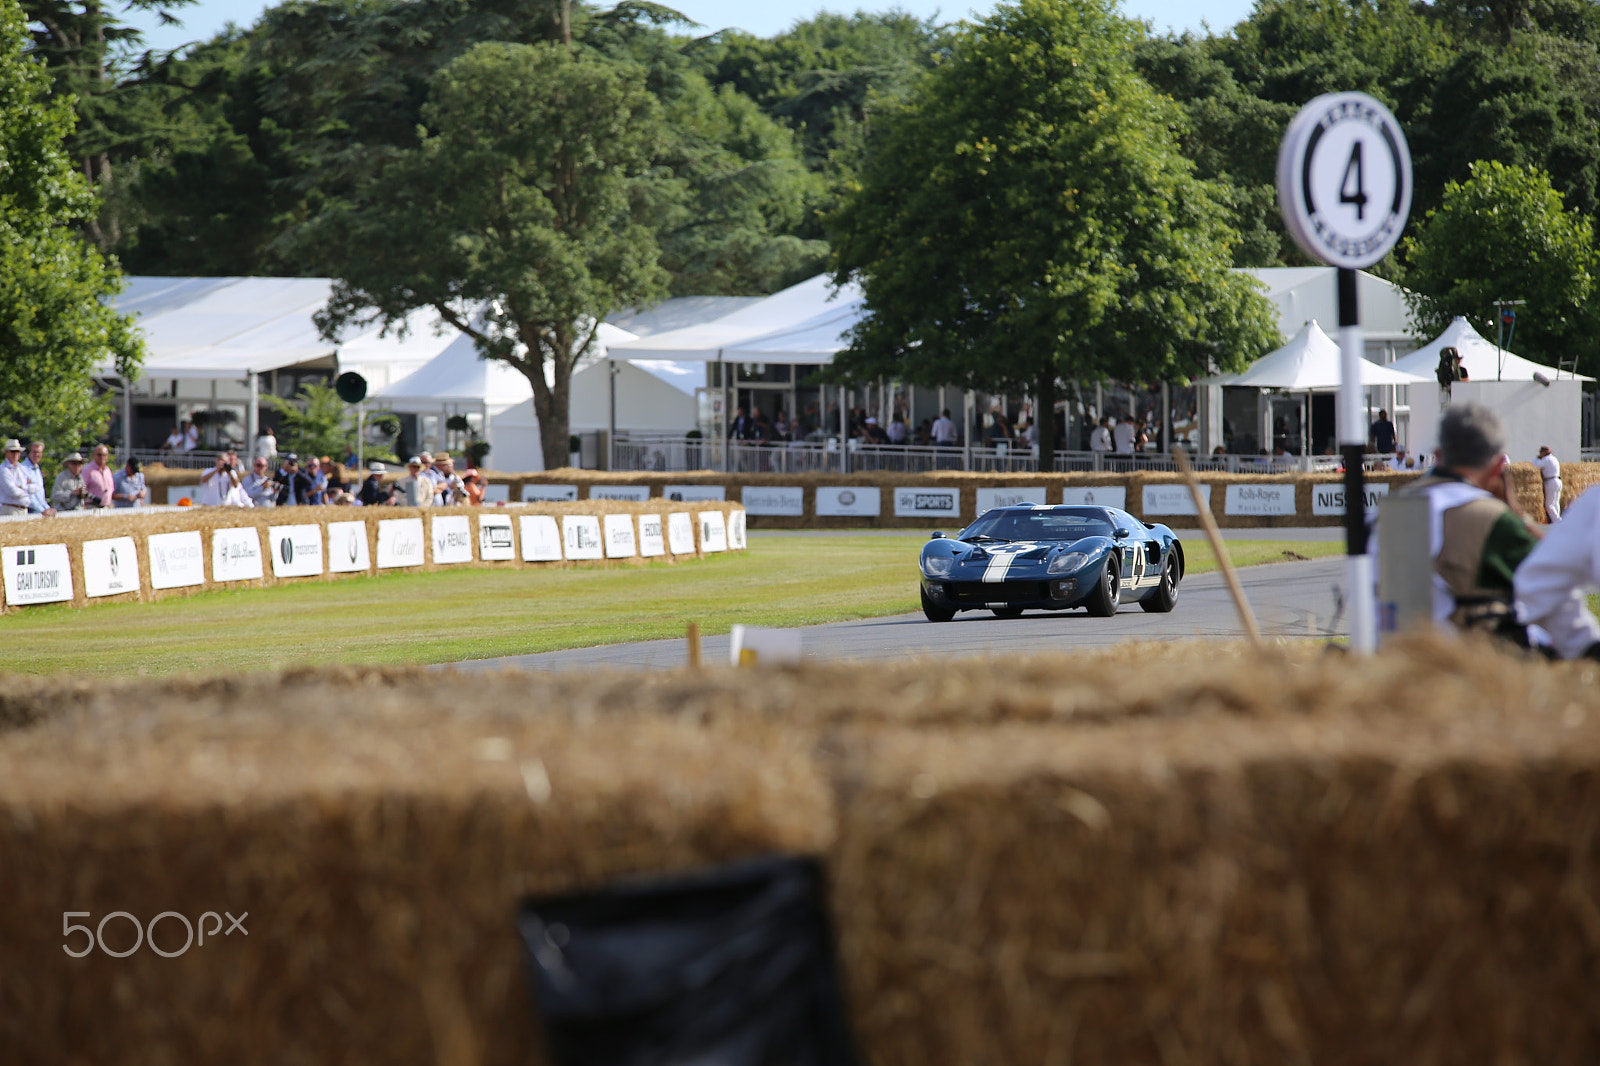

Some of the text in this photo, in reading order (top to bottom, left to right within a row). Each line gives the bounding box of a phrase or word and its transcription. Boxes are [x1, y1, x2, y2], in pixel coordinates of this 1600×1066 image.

[1339, 140, 1368, 220] 4
[916, 495, 953, 509] SPORTS
[1239, 487, 1281, 502] Rolls-Royce
[1318, 491, 1381, 507] NISN
[1134, 546, 1144, 586] 4
[17, 569, 60, 591] GRAN TURISMO
